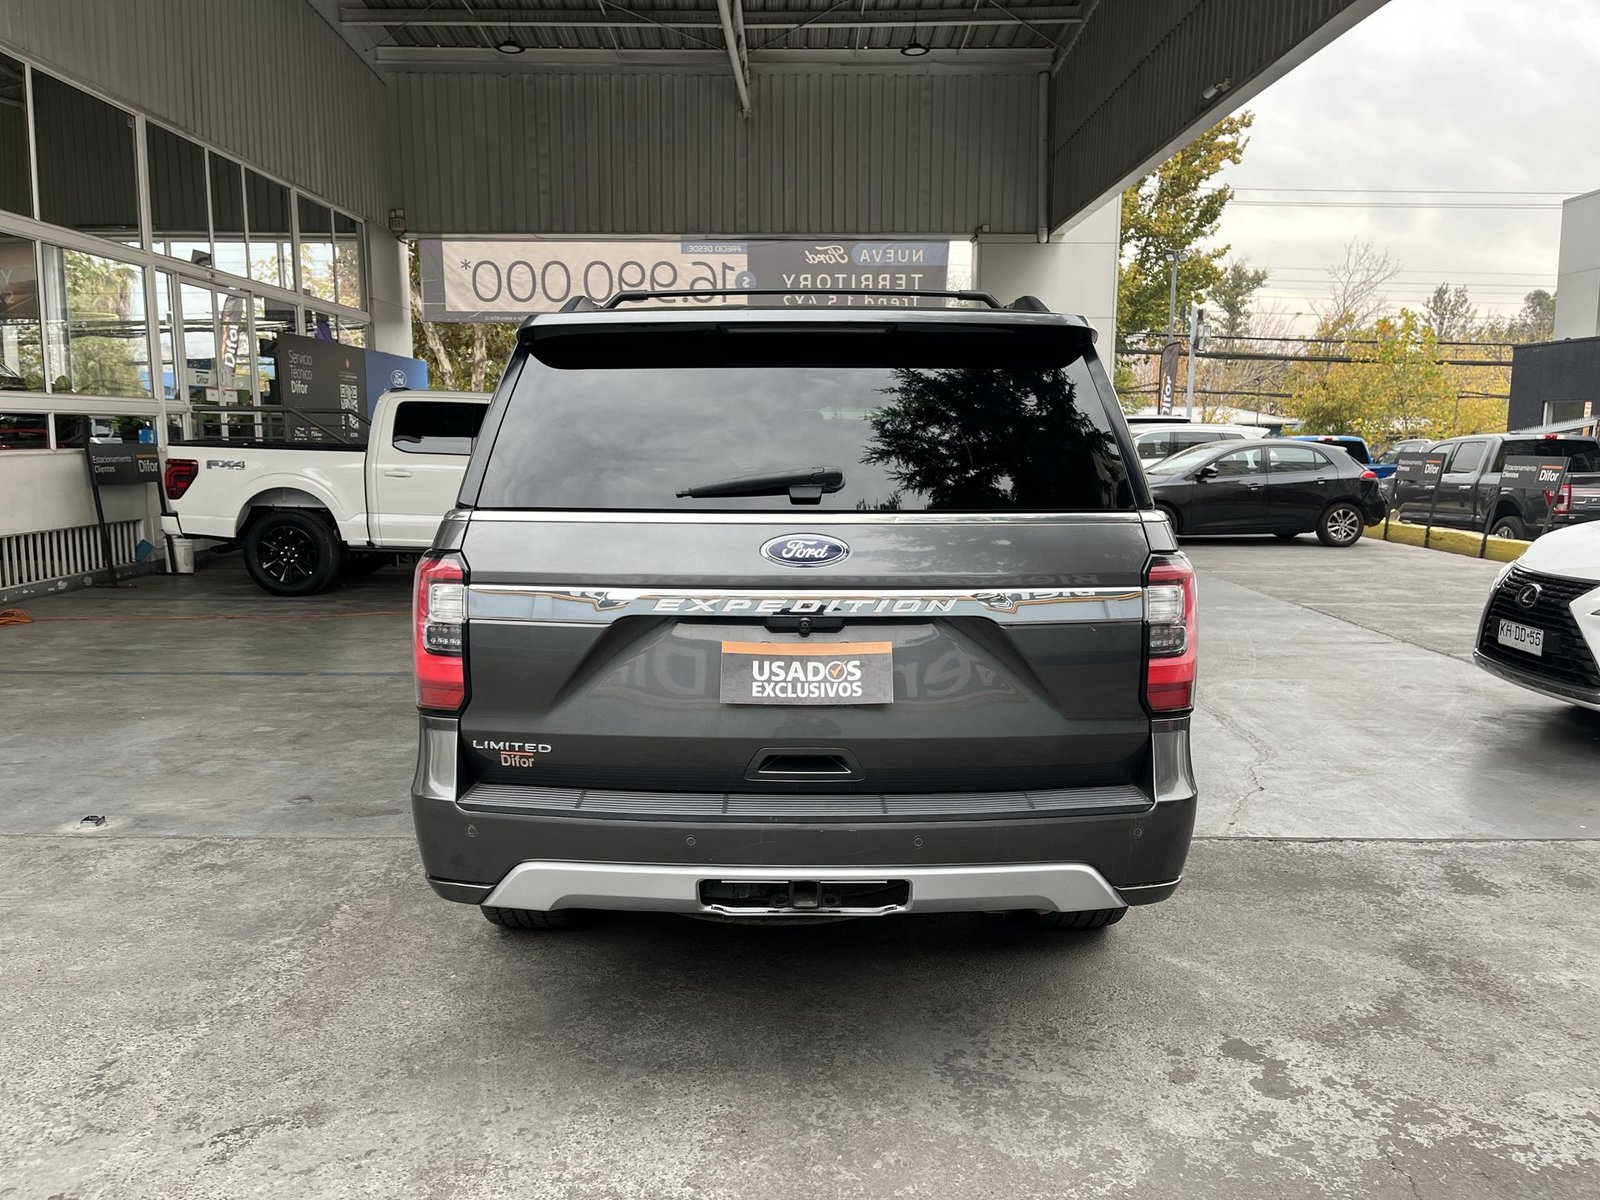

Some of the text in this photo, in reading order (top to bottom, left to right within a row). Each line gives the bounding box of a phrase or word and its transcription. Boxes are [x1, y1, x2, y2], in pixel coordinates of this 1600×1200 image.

[288, 349, 312, 366] Servicio
[290, 380, 308, 394] Difor
[92, 455, 132, 464] Estacionamiento
[206, 460, 246, 470] FX4
[94, 465, 116, 474] Clientes
[138, 460, 158, 473] Difor
[1424, 463, 1440, 474] Difor
[1501, 471, 1520, 479] Clientes
[1538, 470, 1560, 482] Difor
[781, 539, 830, 559] Ford
[652, 597, 957, 614] EXPEDITION
[752, 660, 862, 683] USADOS
[752, 682, 863, 698] EXCLUSIVOS
[472, 740, 552, 753] LIMITED
[500, 754, 535, 768] Difor
